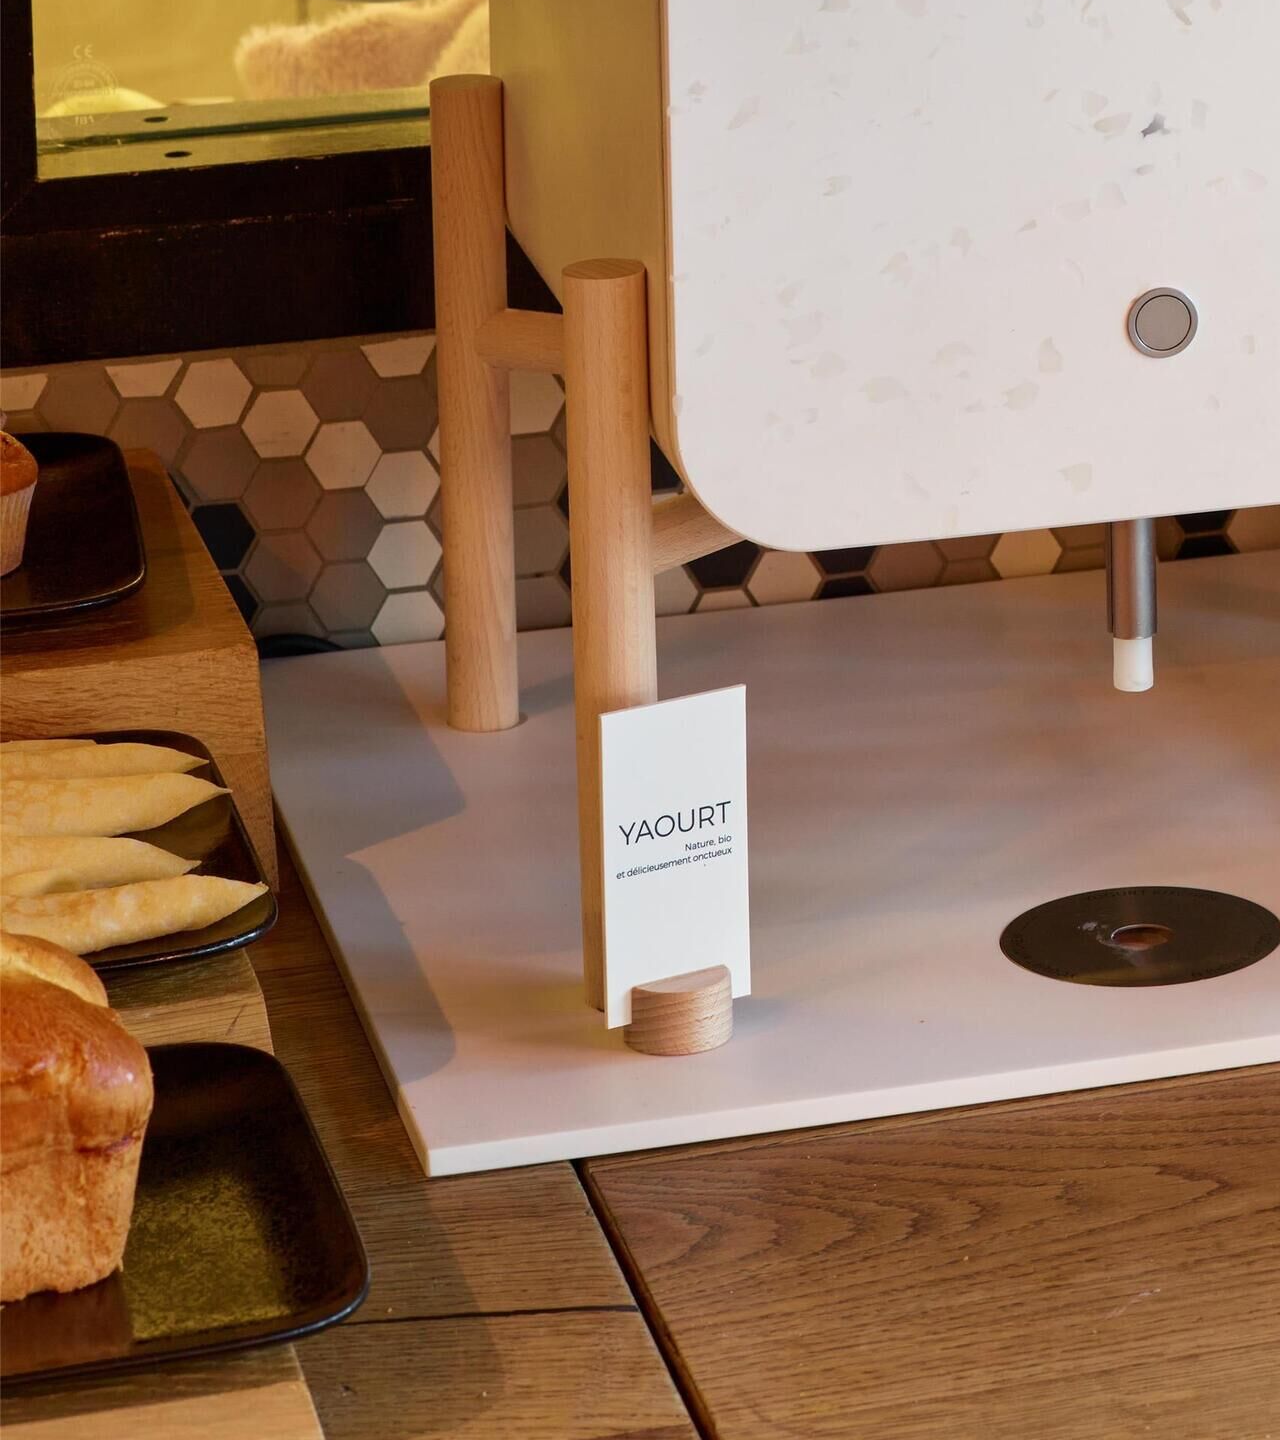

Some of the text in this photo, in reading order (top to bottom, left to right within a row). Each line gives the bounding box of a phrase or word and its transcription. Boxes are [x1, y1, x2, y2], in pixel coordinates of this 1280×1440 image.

[618, 800, 732, 846] YAOURT
[684, 834, 732, 852] Nature, bio
[615, 846, 733, 880] et délicieusement onctueux
